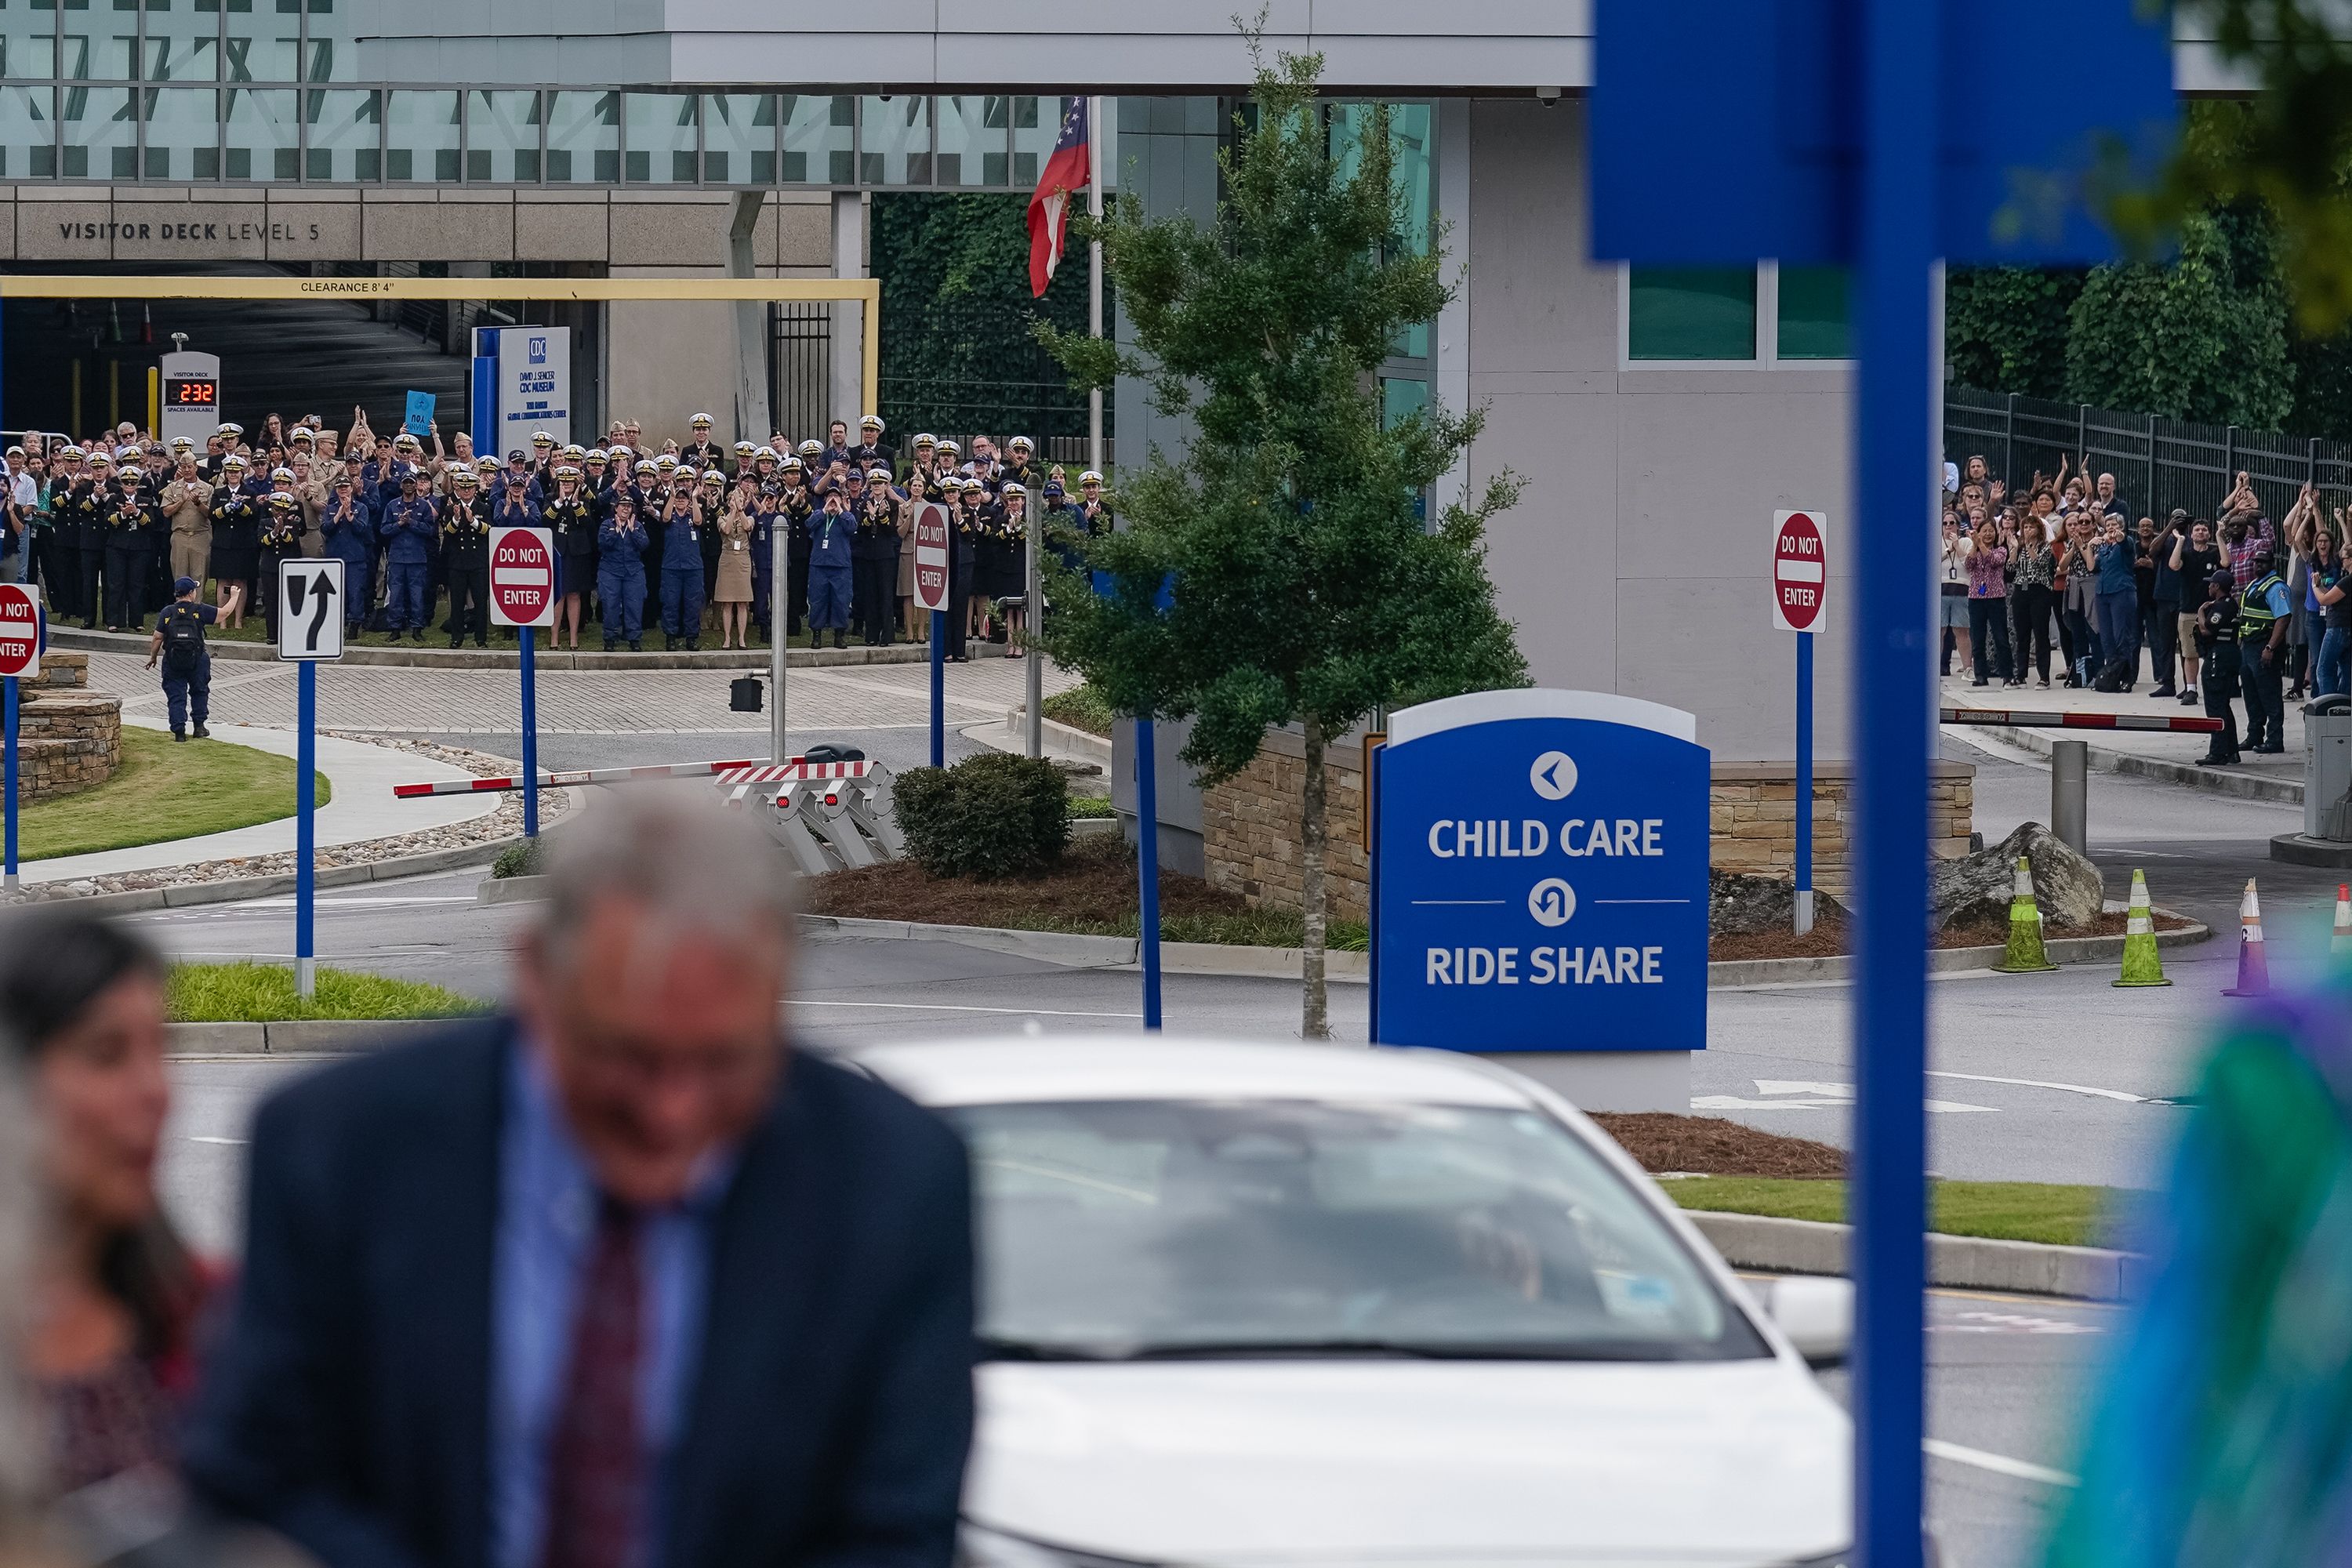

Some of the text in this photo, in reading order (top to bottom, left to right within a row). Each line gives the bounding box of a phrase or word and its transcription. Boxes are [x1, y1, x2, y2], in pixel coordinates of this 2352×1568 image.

[60, 223, 319, 240] VISITOR DECK LEVEL 5
[301, 282, 368, 292] CLEARANCE
[372, 282, 380, 292] 8'
[530, 339, 546, 357] CDC
[519, 372, 533, 381] DAVID
[537, 371, 555, 380] SENCER
[180, 383, 212, 401] 232
[520, 381, 555, 394] CDC MUSEUM
[411, 414, 425, 423] YOU
[920, 524, 944, 543] DO NOT
[1781, 535, 1818, 555] DO NOT
[499, 548, 543, 563] DO NOT
[921, 570, 942, 588] ENTER
[503, 590, 541, 604] ENTER
[1784, 587, 1815, 607] ENTER
[5, 603, 29, 618] NOT
[0, 643, 26, 657] NTER
[1428, 818, 1664, 858] CHILD CARE
[1426, 946, 1664, 985] RIDE SHARE
